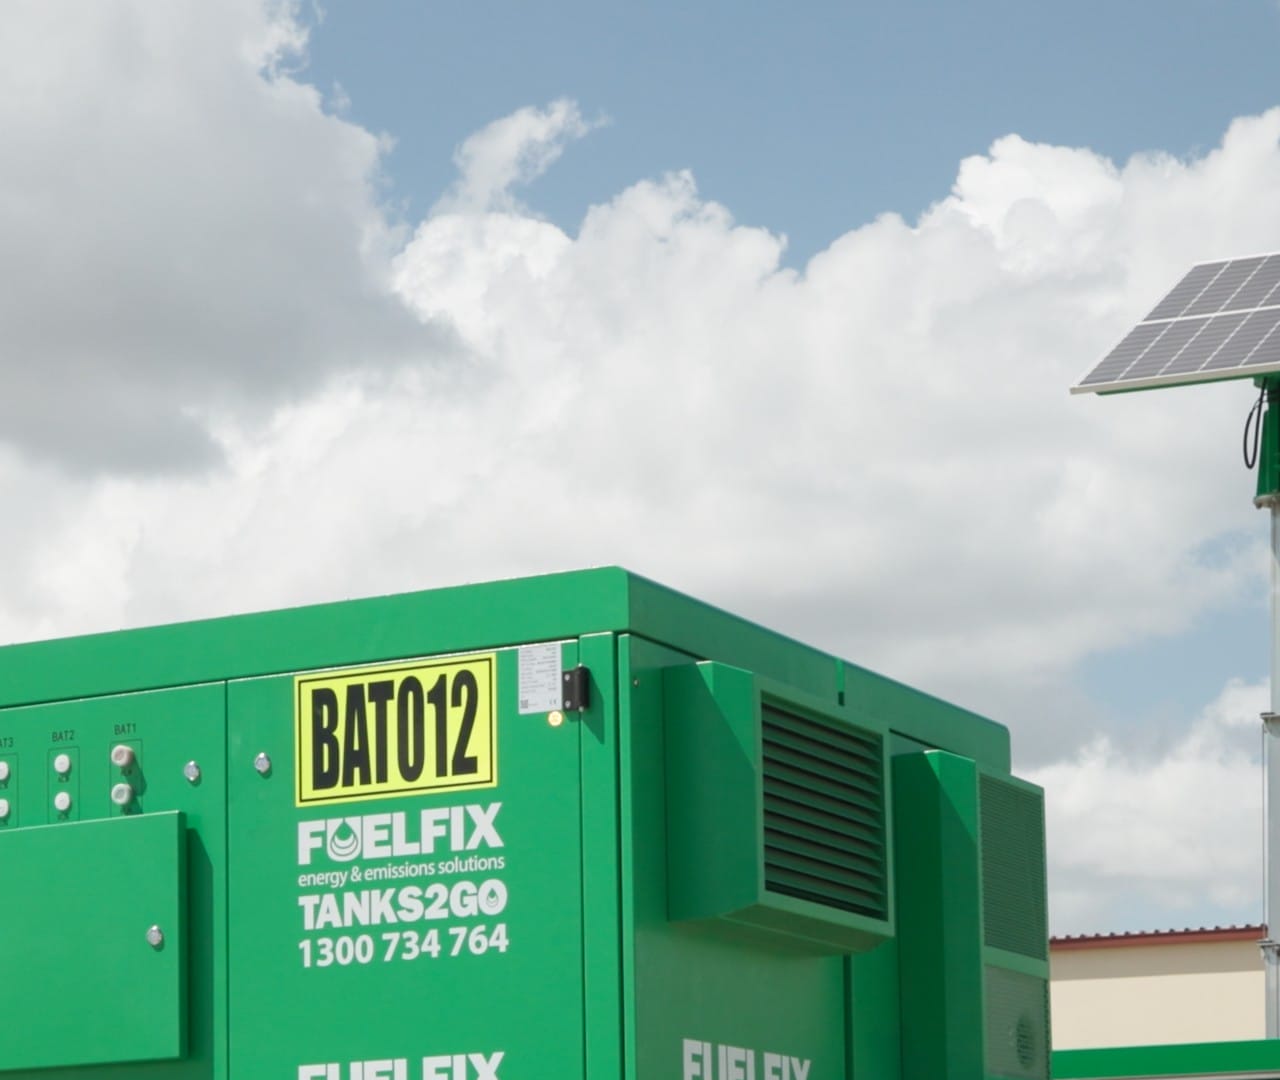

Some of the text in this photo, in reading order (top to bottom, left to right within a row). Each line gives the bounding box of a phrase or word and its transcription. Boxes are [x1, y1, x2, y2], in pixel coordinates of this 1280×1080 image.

[52, 730, 75, 742] BAT2
[114, 723, 137, 736] BAT1
[311, 669, 479, 791] BAT012
[298, 802, 505, 865] FUELFIX
[298, 855, 505, 888] energy & emissions solutions
[298, 878, 508, 930] TANKS2GO
[298, 923, 509, 968] 1300 734 764
